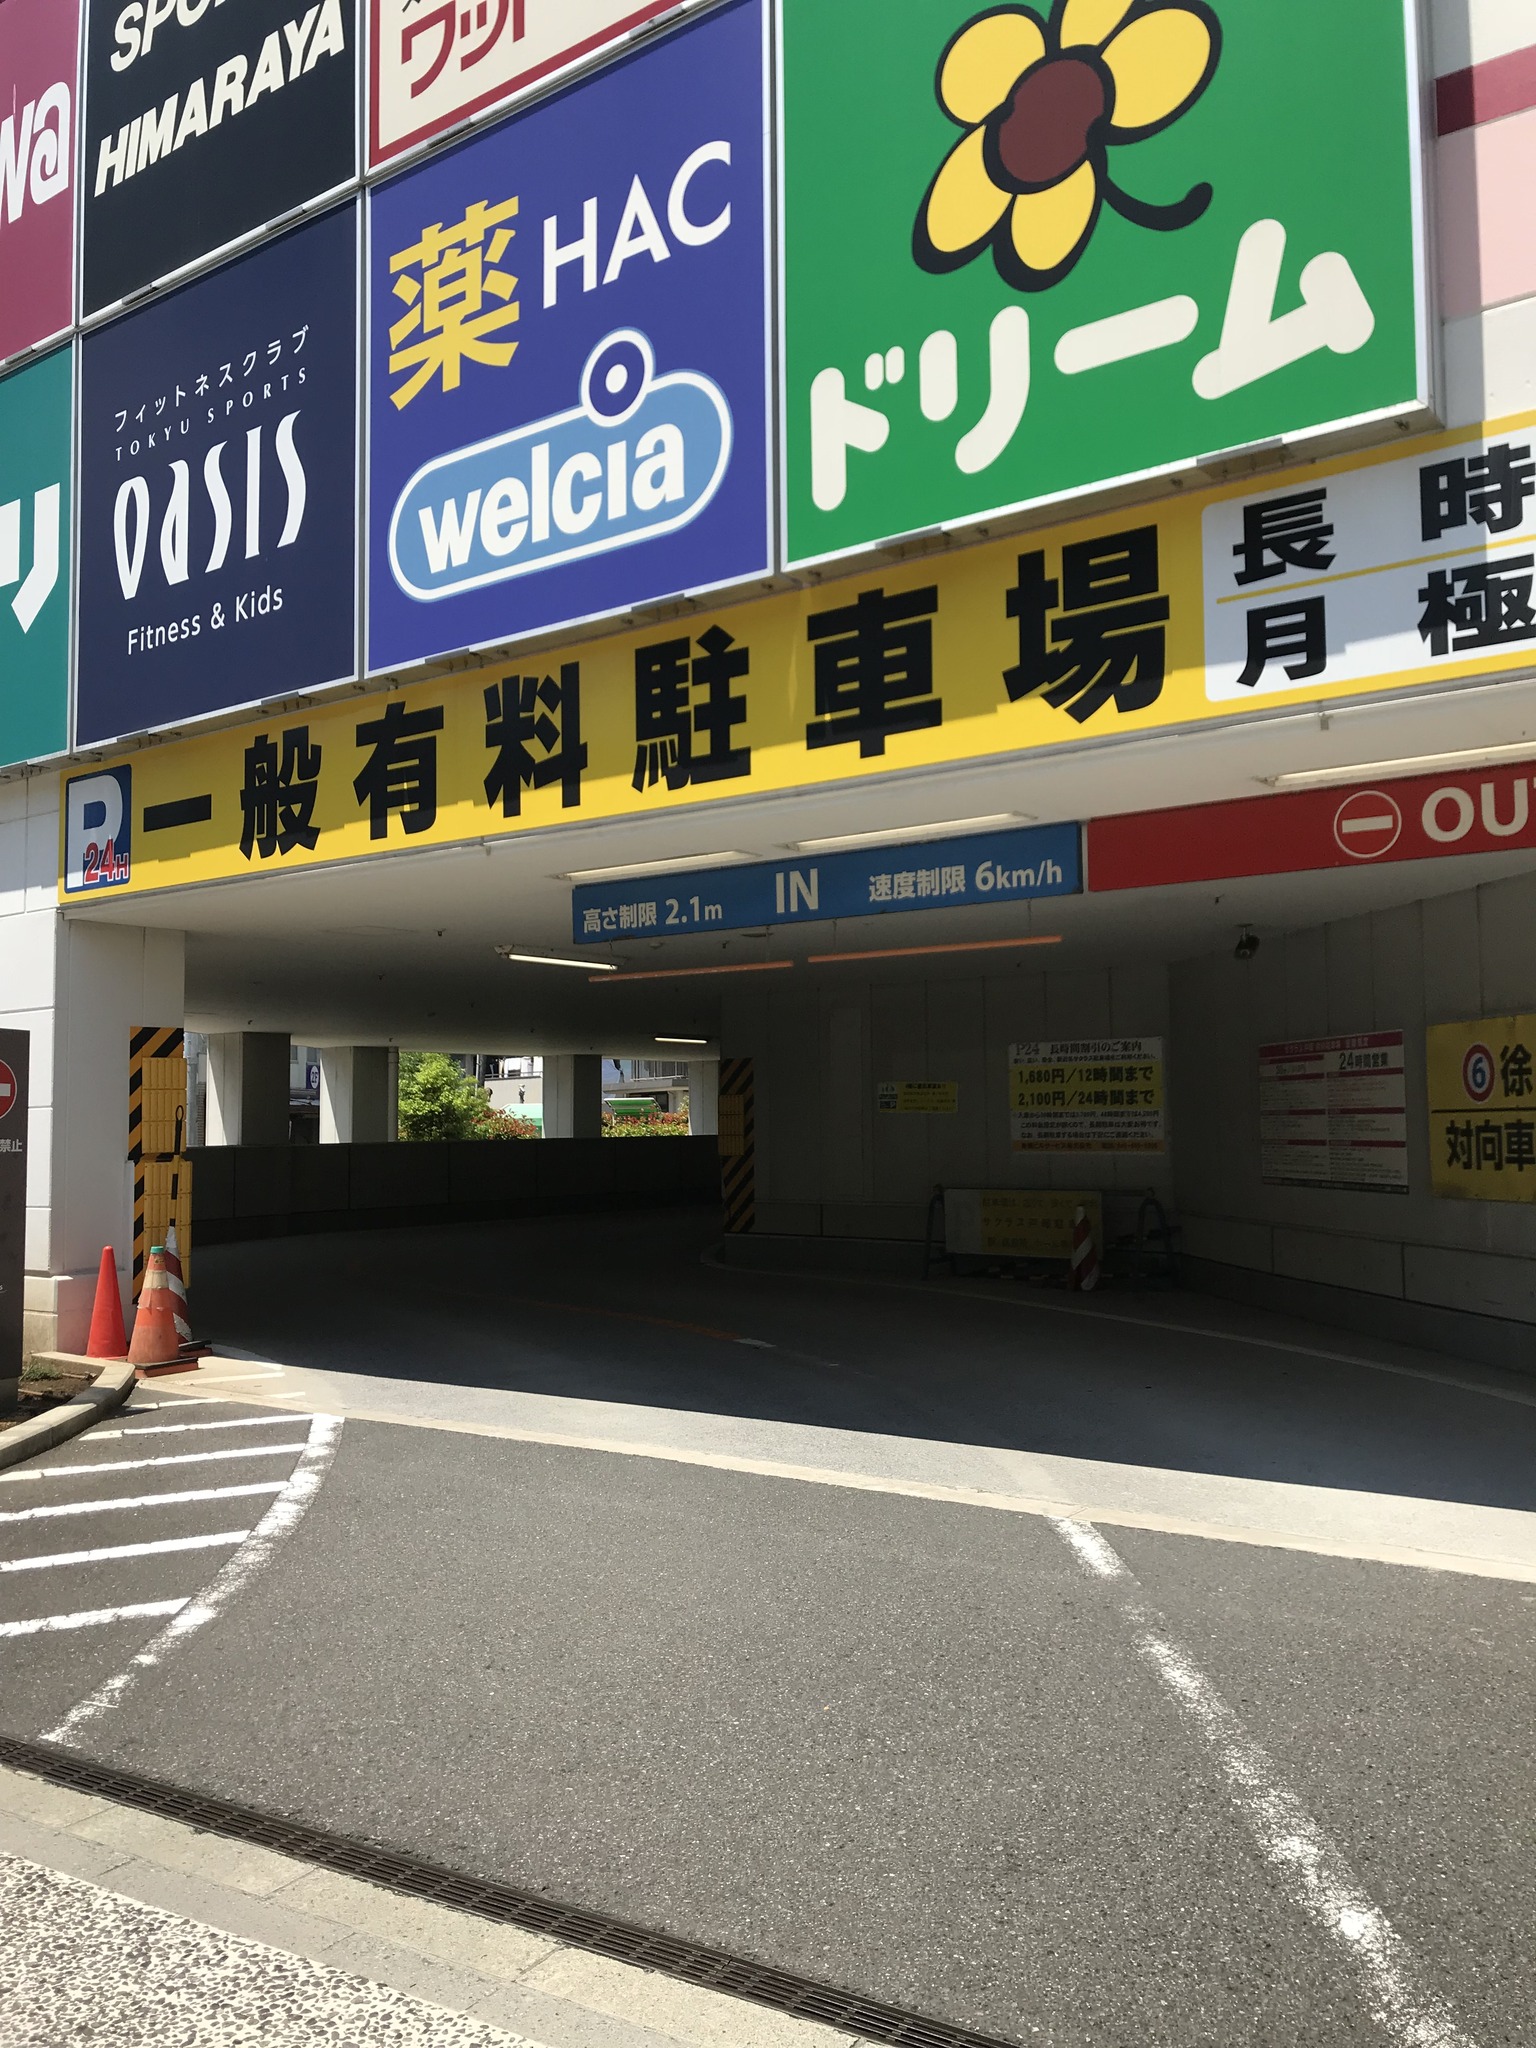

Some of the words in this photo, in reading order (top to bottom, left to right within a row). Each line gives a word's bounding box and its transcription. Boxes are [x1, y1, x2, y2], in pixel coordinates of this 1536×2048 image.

[94, 0, 345, 198] HIMARAYA
[389, 195, 520, 411] 薬
[543, 140, 731, 309] HAC
[115, 324, 309, 432] フィットネスクラブ
[810, 218, 1375, 511] ドリーム
[115, 418, 190, 461] TOKYU
[207, 367, 306, 424] SPORTS
[418, 423, 685, 574] welcia
[127, 614, 201, 655] Fitness
[210, 602, 225, 629] &
[235, 585, 283, 622] Kids
[143, 525, 1170, 862] 一般有料駐車場
[1421, 778, 1536, 843] OU
[583, 902, 657, 933] 高さ制限
[665, 895, 723, 924] 2.1m
[775, 868, 819, 914] IN
[869, 865, 966, 901] 速度制限
[975, 859, 1062, 891] 6km/h
[1500, 1043, 1533, 1098] 徐
[1446, 1119, 1535, 1172] 対向車
